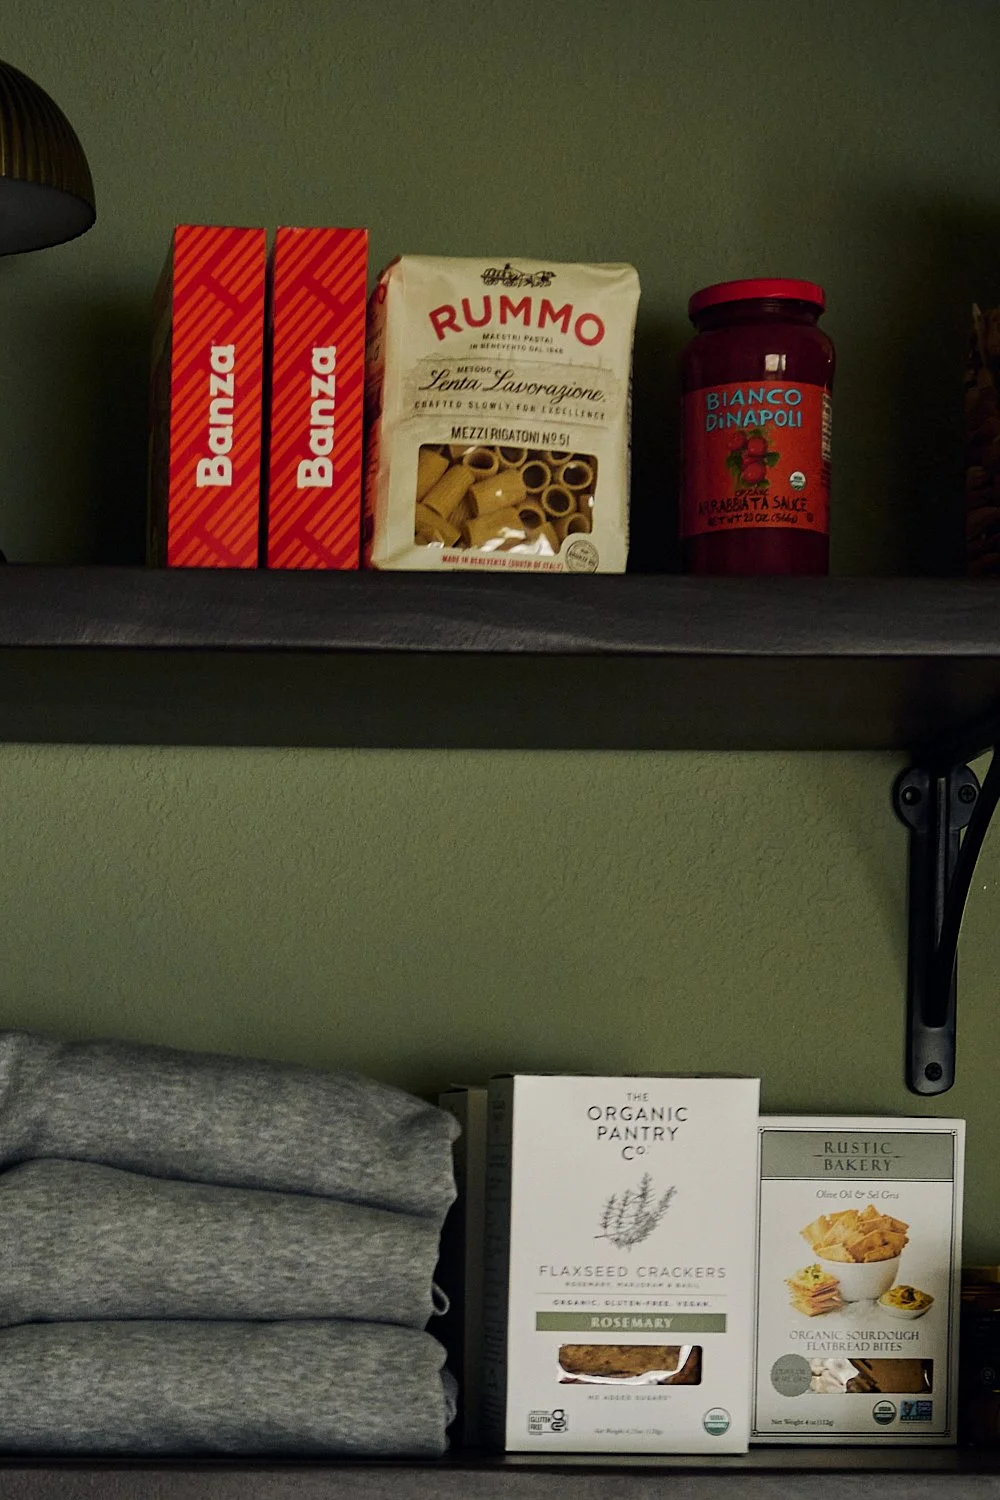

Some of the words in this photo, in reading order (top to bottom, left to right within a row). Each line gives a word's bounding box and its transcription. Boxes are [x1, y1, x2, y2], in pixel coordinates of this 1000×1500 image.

[428, 295, 605, 346] RUMMO
[418, 368, 482, 393] Lenta
[706, 388, 802, 411] BIANCO
[414, 401, 462, 409] CRAFTED
[468, 401, 510, 411] SLOWLY
[516, 403, 536, 413] FOR
[196, 344, 235, 488] Banza
[297, 346, 337, 488] Banza
[773, 496, 807, 512] SAUCE
[627, 1093, 648, 1102] THE
[587, 1106, 689, 1122] ORGANIC
[597, 1126, 679, 1141] PANTRY
[824, 1141, 893, 1154] RUSTIC
[824, 1159, 893, 1171] BAKERY
[539, 1265, 629, 1277] FLAXSEED
[636, 1266, 726, 1279] CRACKERS
[590, 1316, 673, 1329] ROSEMARY
[789, 1330, 844, 1340] ORGANIC
[846, 1330, 919, 1341] SOURDOUGH
[807, 1342, 870, 1351] FLATBREAD
[873, 1342, 903, 1351] BITES
